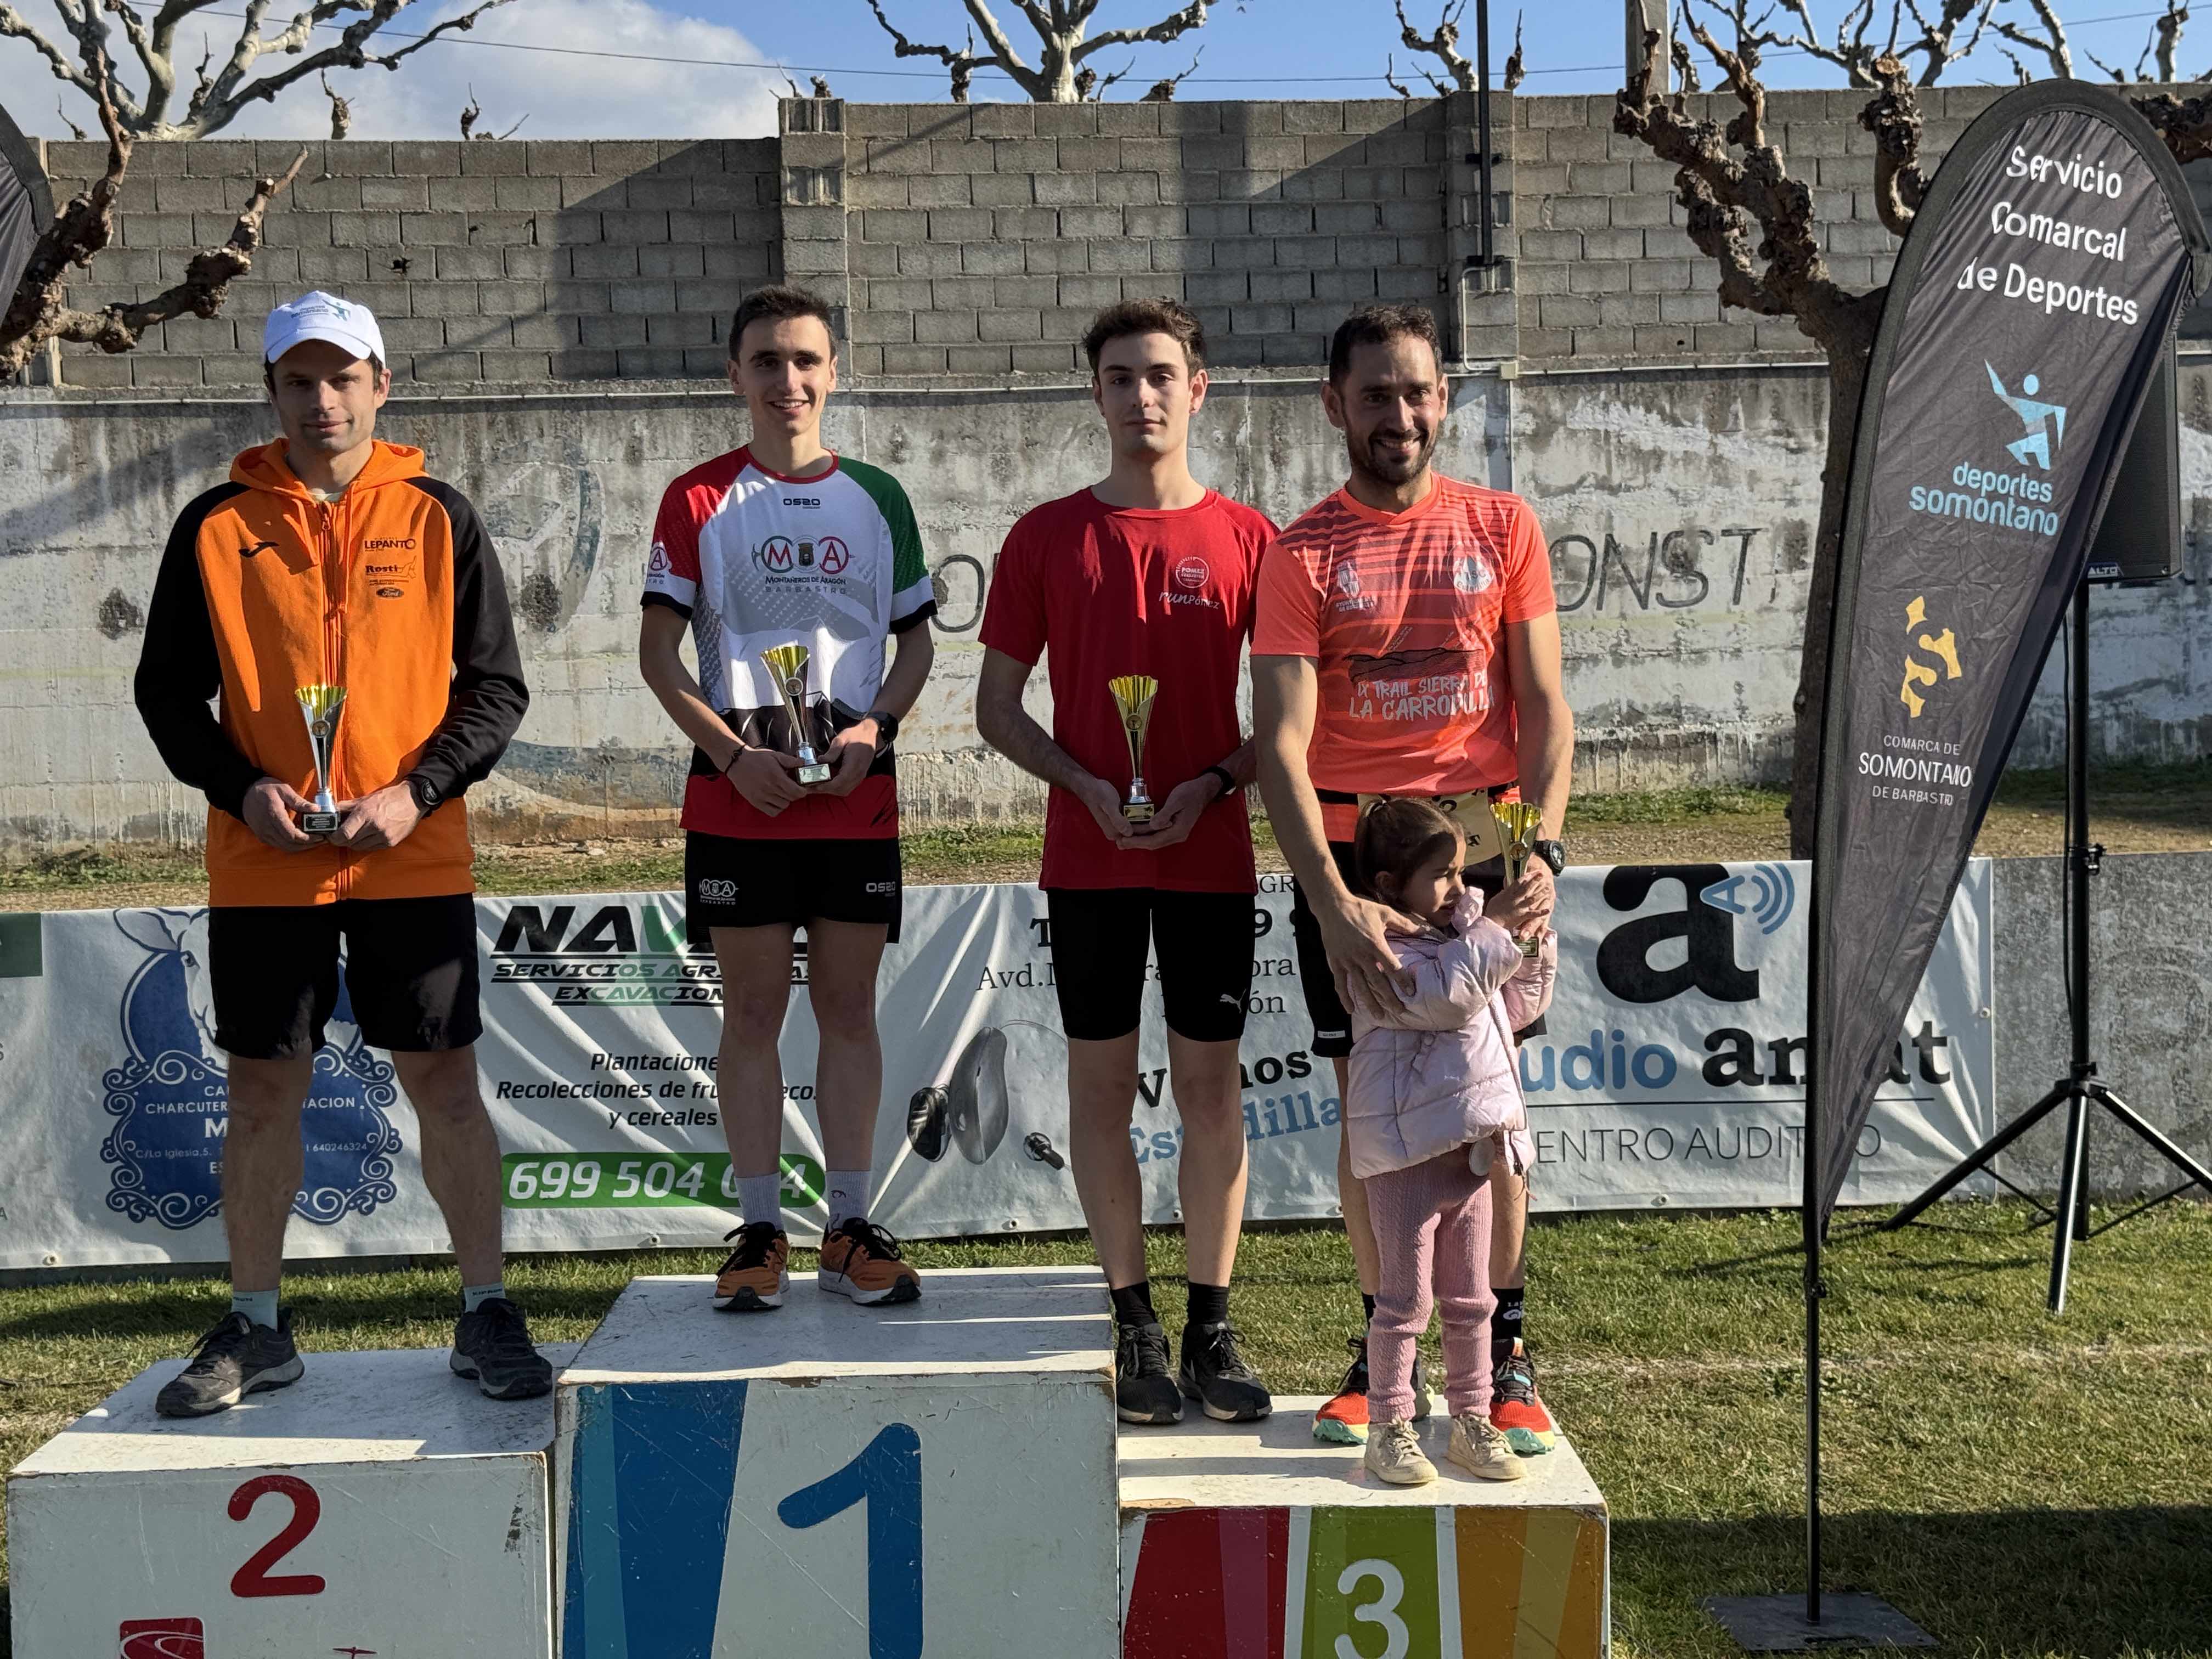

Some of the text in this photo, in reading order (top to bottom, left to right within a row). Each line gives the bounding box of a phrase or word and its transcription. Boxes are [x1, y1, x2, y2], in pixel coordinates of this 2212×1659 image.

[2006, 145, 2123, 200] Servicio
[1991, 201, 2127, 262] Comarcal
[1957, 257, 2138, 325] de Deportes
[1953, 461, 2053, 504] deportes
[1909, 486, 2058, 536] somontano
[365, 538, 416, 549] LEPANTO
[1348, 685, 1495, 721] LA CARRODILLA
[1373, 680, 1413, 700] TRAIL
[1418, 675, 1469, 694] SIERRA
[1883, 734, 1961, 755] COMARCA DE
[1872, 785, 1890, 799] DE
[494, 964, 658, 978] SERVICIOS
[555, 986, 723, 1001] EXCAVACION
[590, 1053, 718, 1071] Plantacione
[1519, 1029, 1677, 1092] udio
[145, 1101, 228, 1114] CHARCUTER
[496, 1080, 652, 1099] Recolecciones
[659, 1081, 686, 1098] de
[608, 1108, 718, 1129] y cereales
[1536, 1127, 1674, 1164] ENTRO
[509, 1161, 602, 1200] 699
[612, 1161, 707, 1198] 504
[227, 1474, 326, 1598] 2
[776, 1421, 924, 1659] 1
[1334, 1558, 1409, 1659] 3
